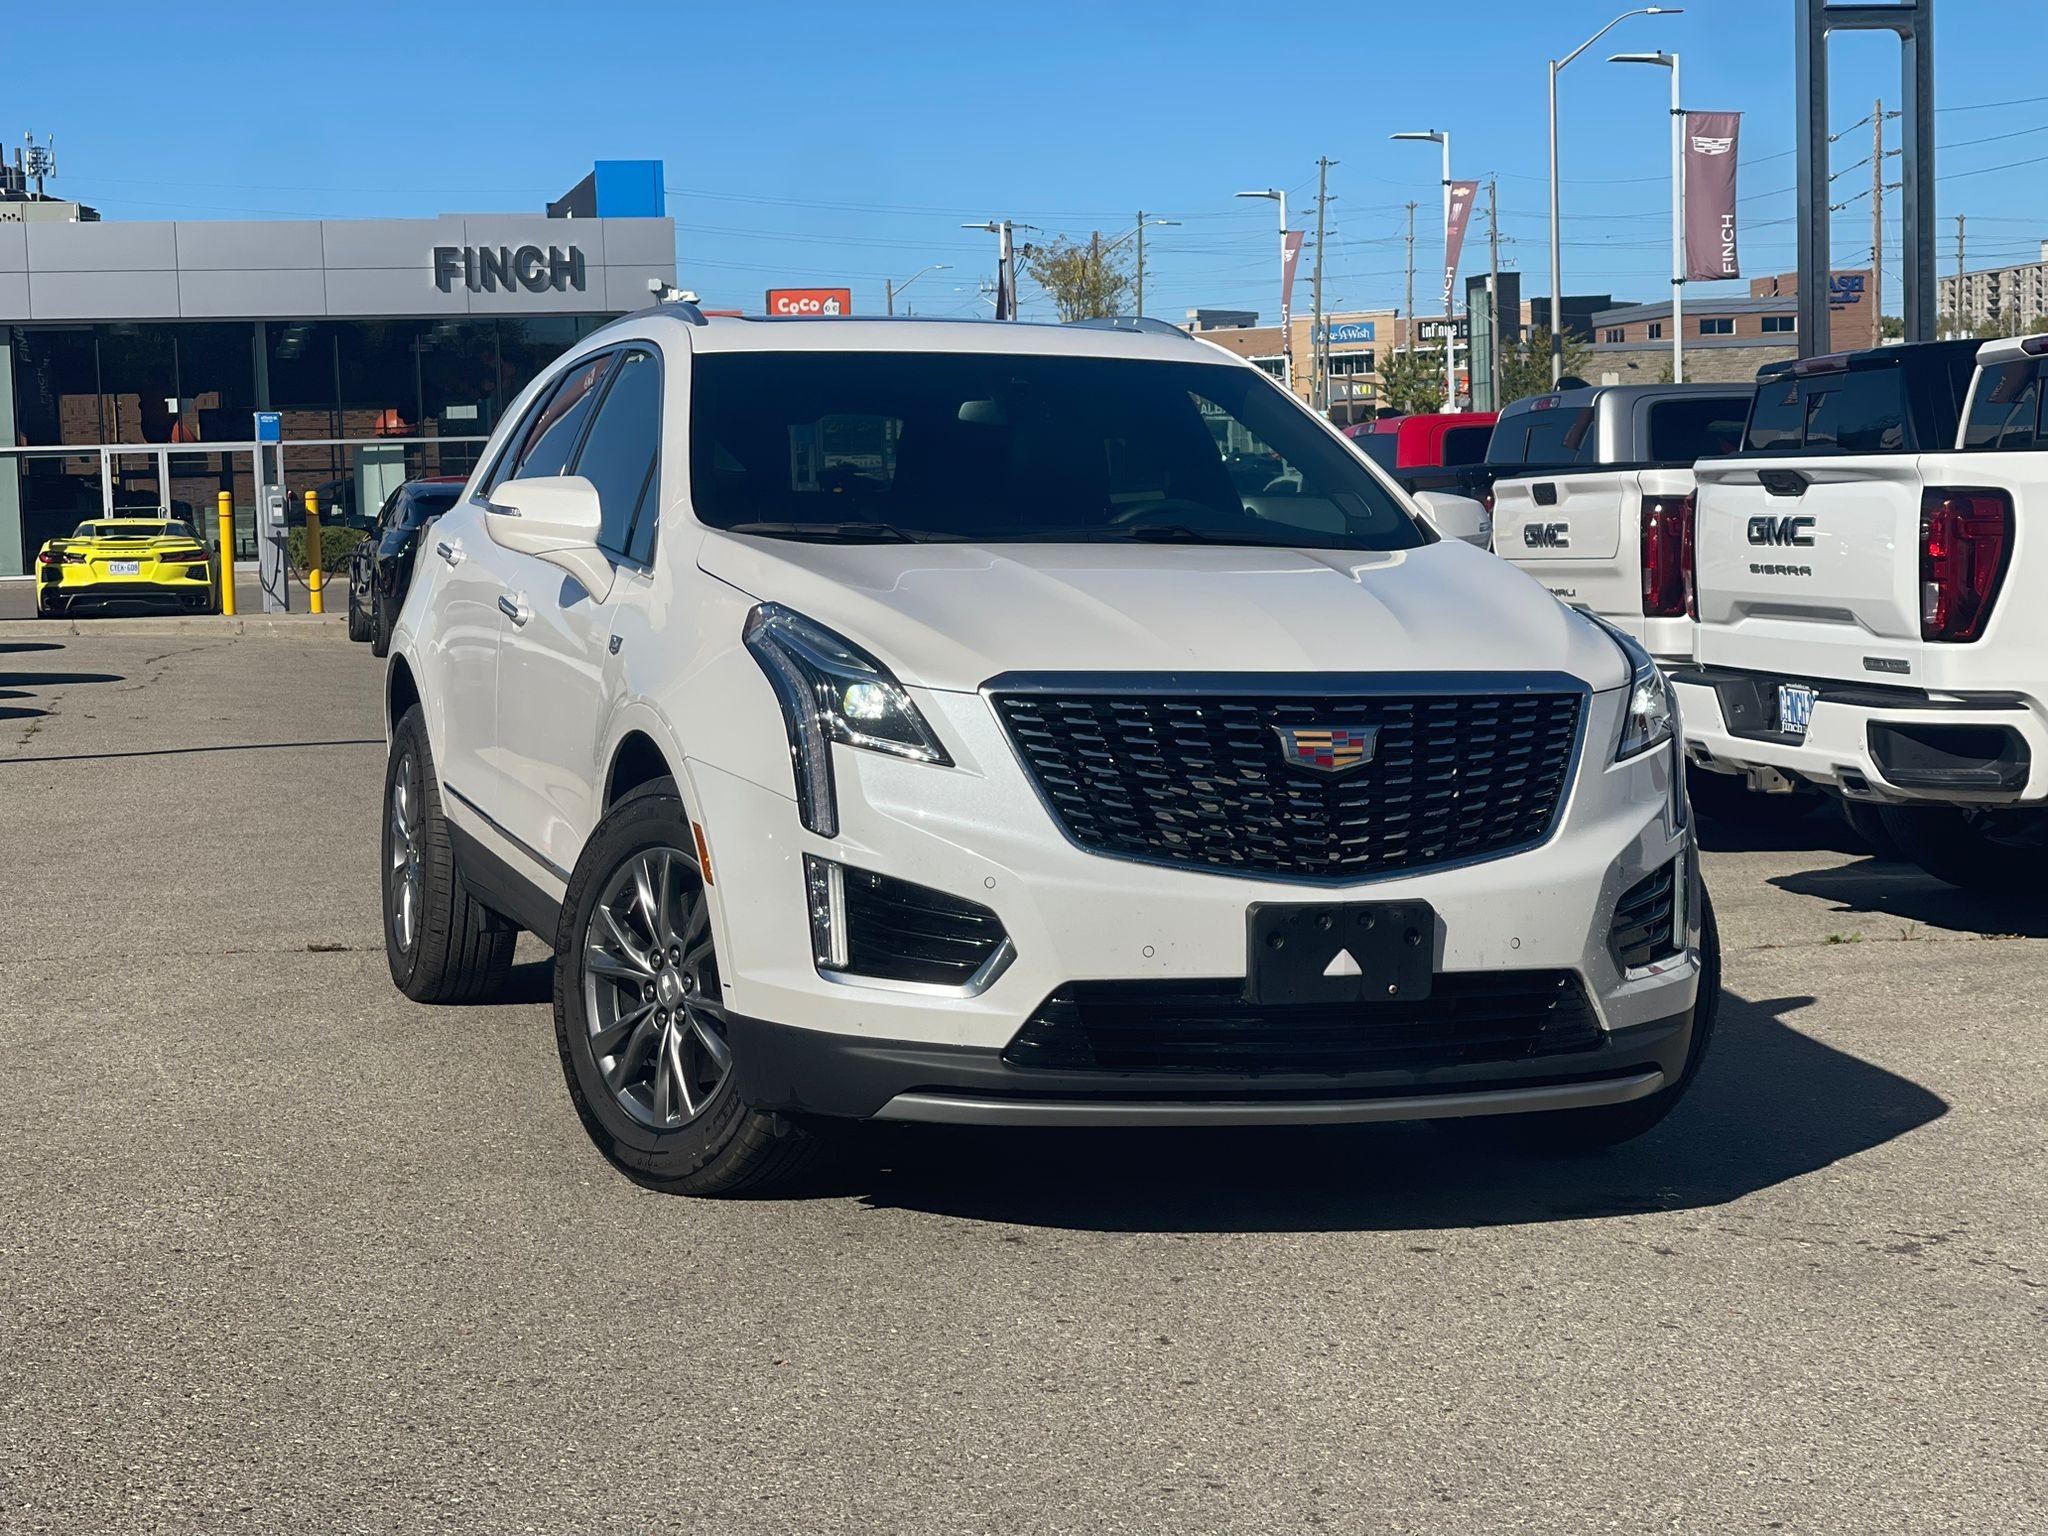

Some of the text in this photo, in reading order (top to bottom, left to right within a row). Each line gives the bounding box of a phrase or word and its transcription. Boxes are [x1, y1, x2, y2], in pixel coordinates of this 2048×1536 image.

[1720, 214, 1736, 273] FINCH
[433, 244, 581, 290] FINCH
[1829, 276, 1865, 292] ASH
[1523, 522, 1570, 548] GMC
[1747, 516, 1816, 547] GMC
[1749, 563, 1812, 577] SIERRA
[1549, 588, 1576, 597] NALI
[1780, 719, 1803, 734] finch
